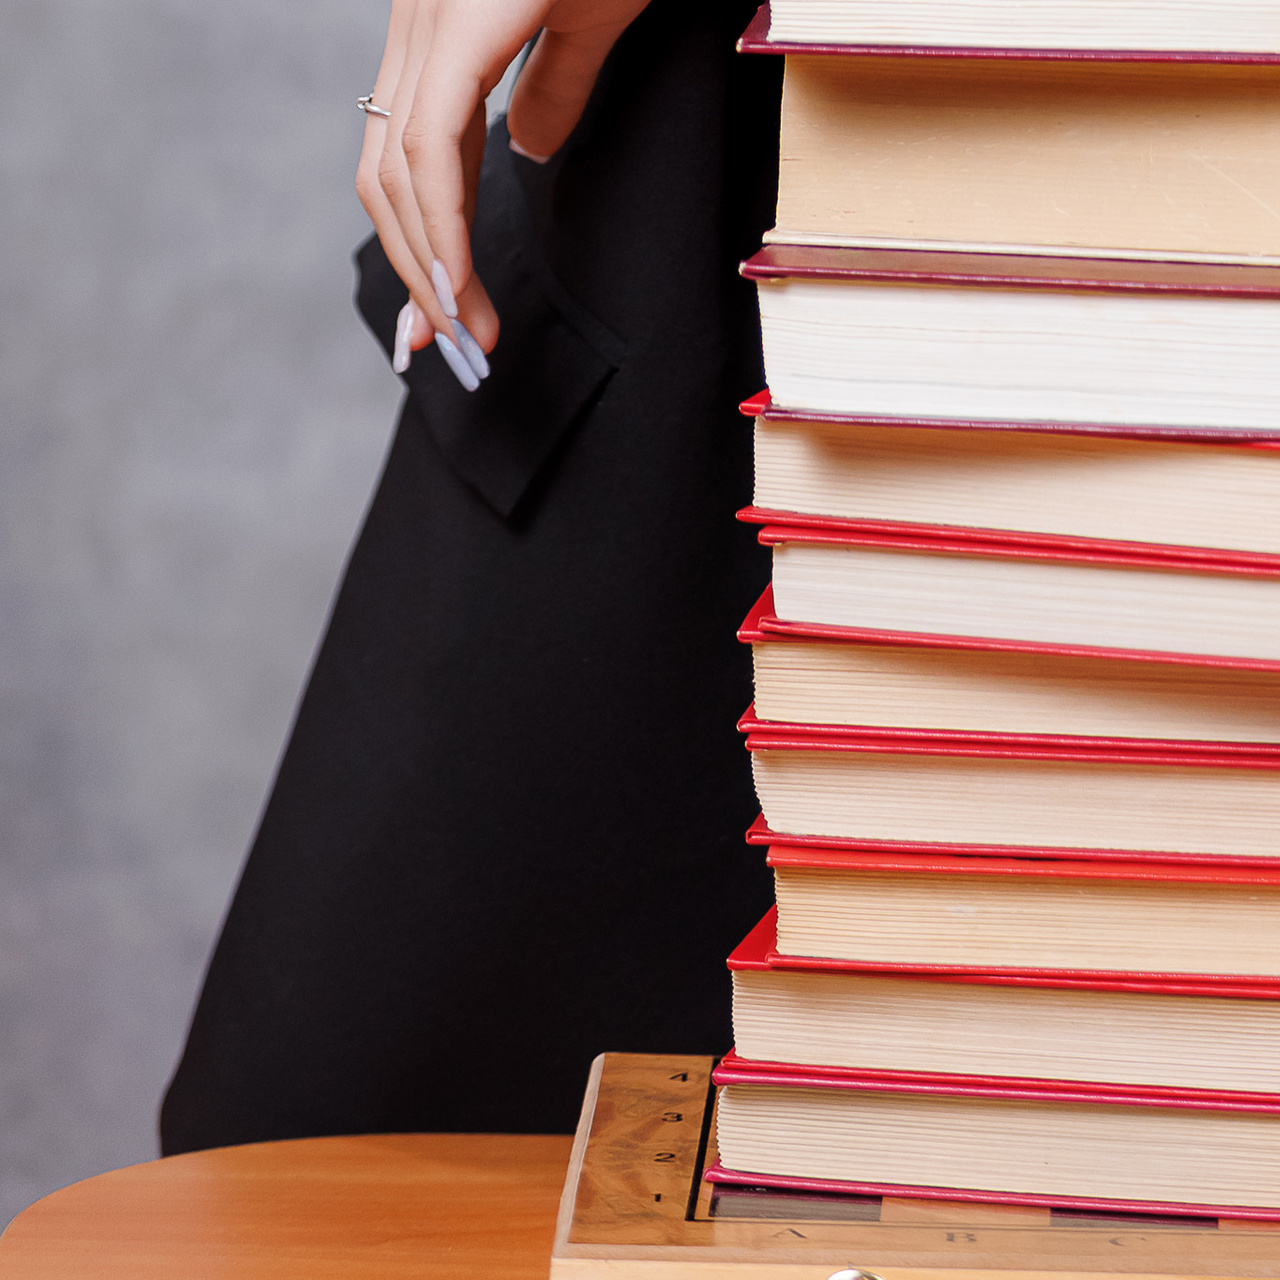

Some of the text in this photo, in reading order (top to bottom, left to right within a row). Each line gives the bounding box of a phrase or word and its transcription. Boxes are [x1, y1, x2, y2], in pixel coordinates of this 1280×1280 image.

[662, 1112, 683, 1122] 3
[654, 1153, 675, 1163] 2
[769, 1228, 808, 1239] A
[945, 1232, 977, 1241] B
[1109, 1236, 1147, 1246] C
